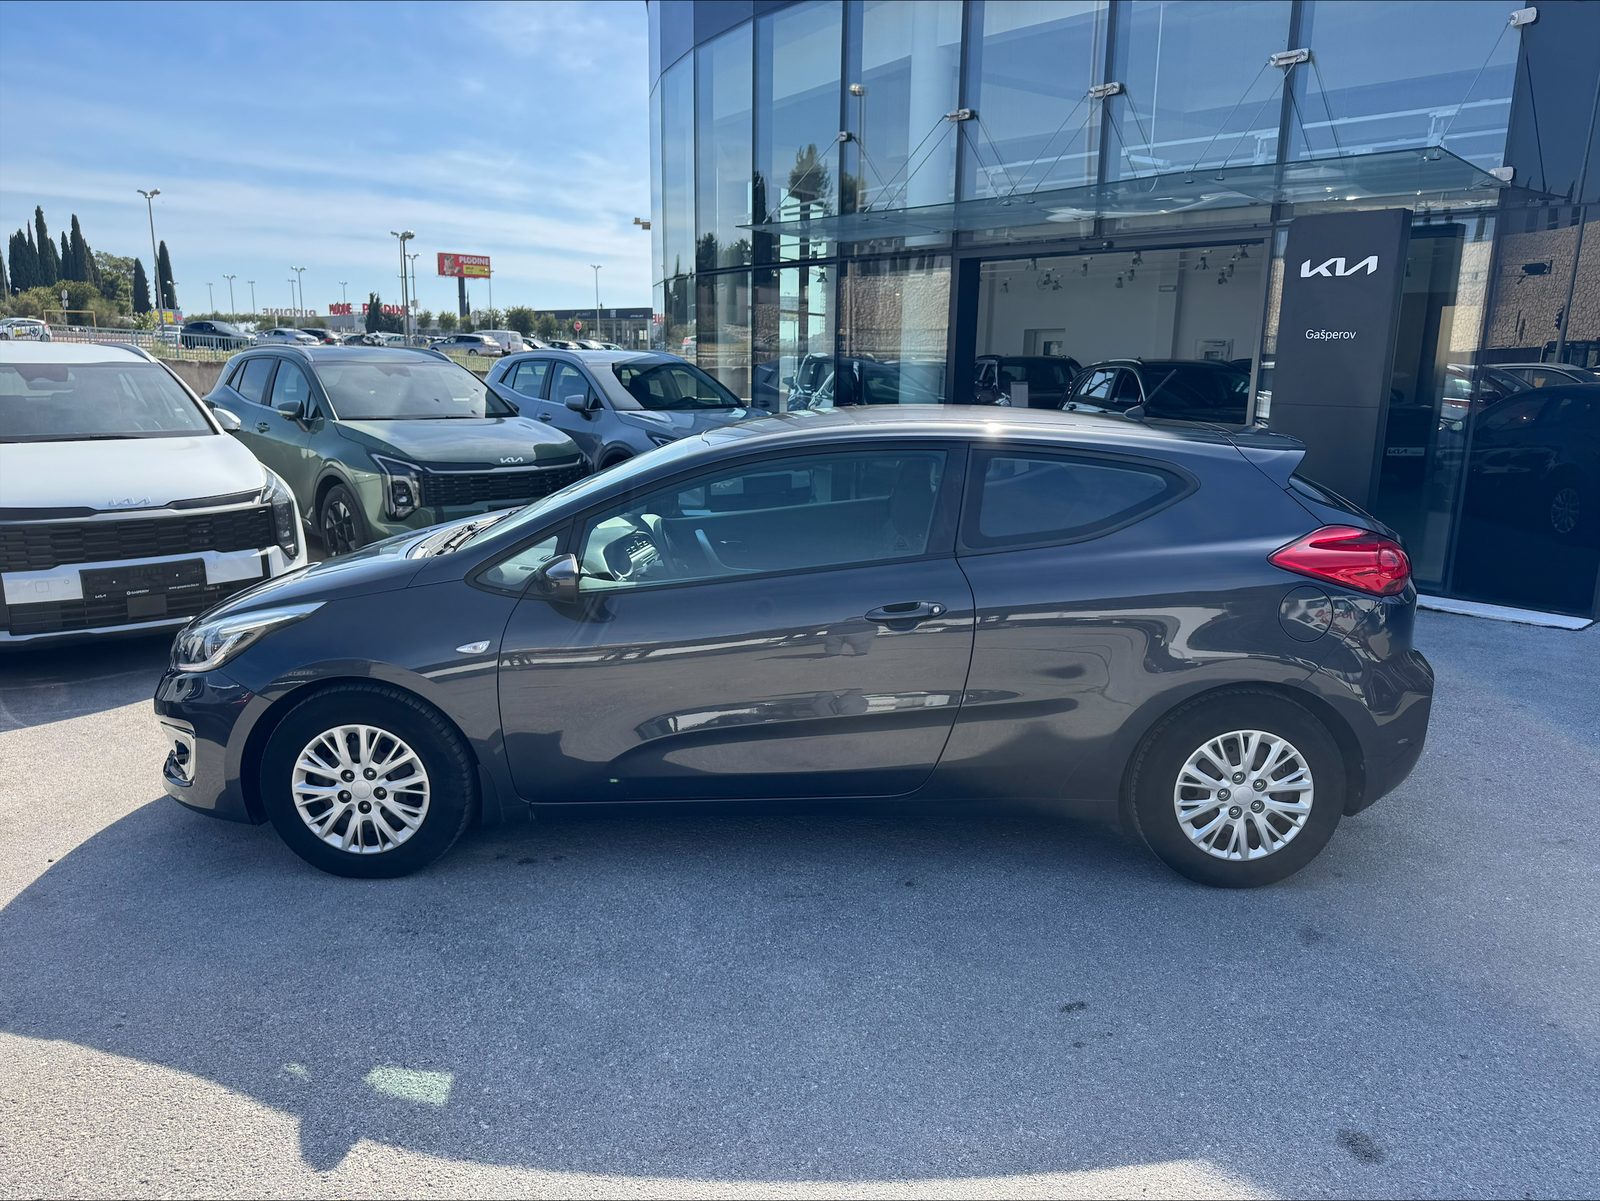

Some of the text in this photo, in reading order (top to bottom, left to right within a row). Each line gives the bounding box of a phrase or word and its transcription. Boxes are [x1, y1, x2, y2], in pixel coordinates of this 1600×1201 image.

[458, 255, 489, 265] PLODINE
[1301, 255, 1378, 278] KIA
[1305, 328, 1357, 341] Gašperov
[500, 455, 523, 464] KIA
[108, 495, 152, 507] KIA
